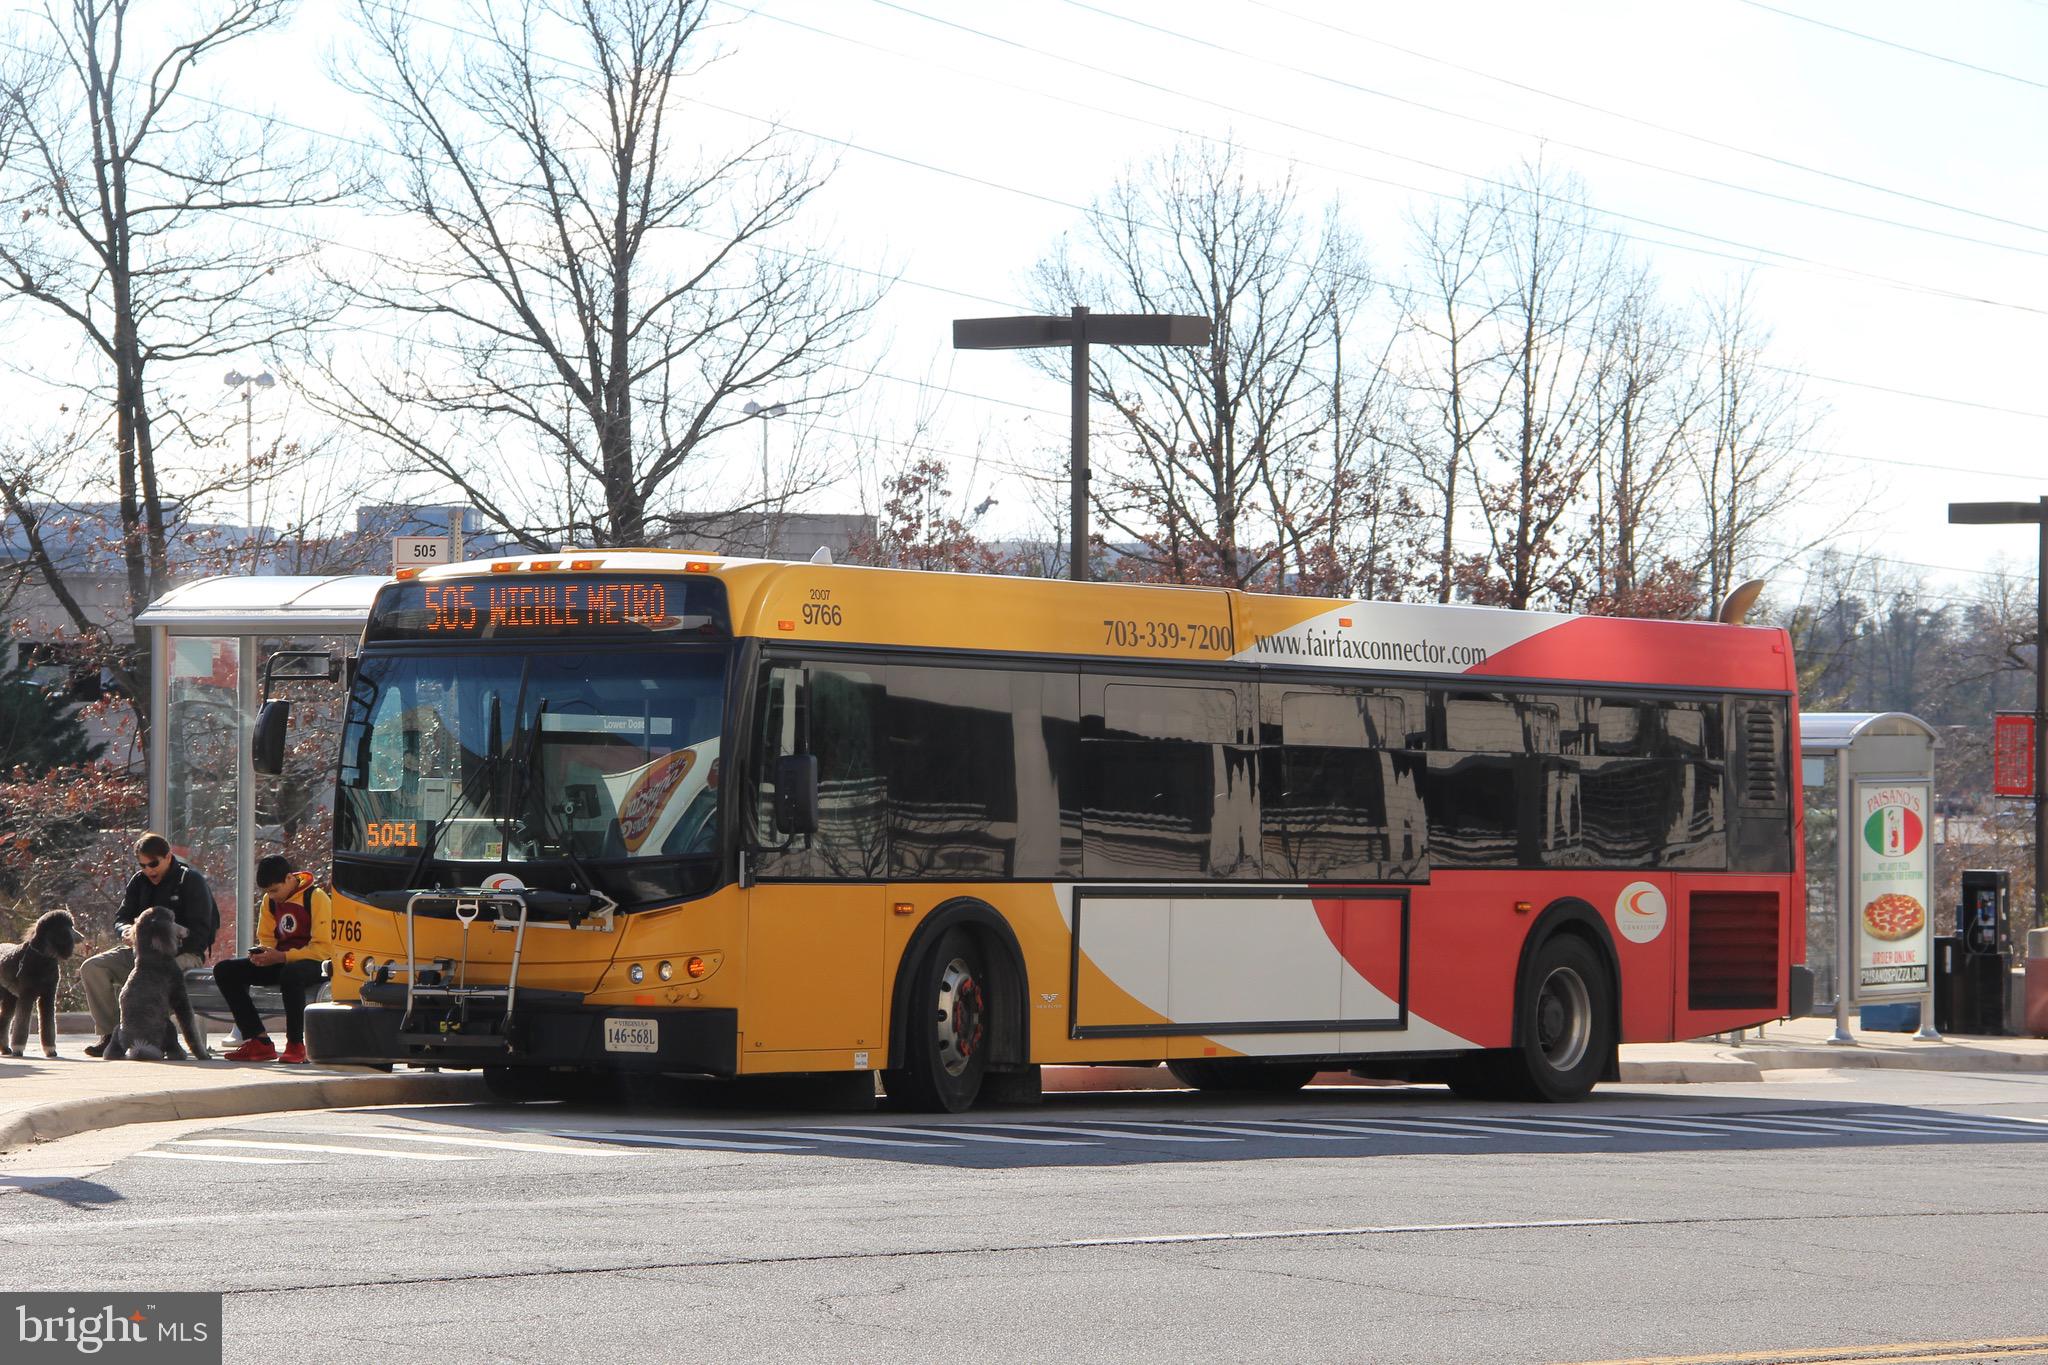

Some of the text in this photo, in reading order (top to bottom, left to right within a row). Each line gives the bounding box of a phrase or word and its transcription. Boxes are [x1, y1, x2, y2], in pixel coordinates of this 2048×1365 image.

[414, 544, 436, 557] 505
[809, 588, 831, 600] 2007
[424, 583, 665, 631] 505 WIEHLE METRO
[802, 603, 842, 626] 9766
[1103, 620, 1232, 652] 703-339-7200
[1255, 628, 1487, 666] www.fairfaxconnector.com
[604, 719, 626, 729] Lower
[1867, 789, 1920, 813] PAISANO'S
[367, 823, 418, 848] 5051
[331, 919, 362, 942] 9766
[1872, 950, 1916, 964] ORDER ONLINE
[609, 1028, 655, 1045] 146-568L
